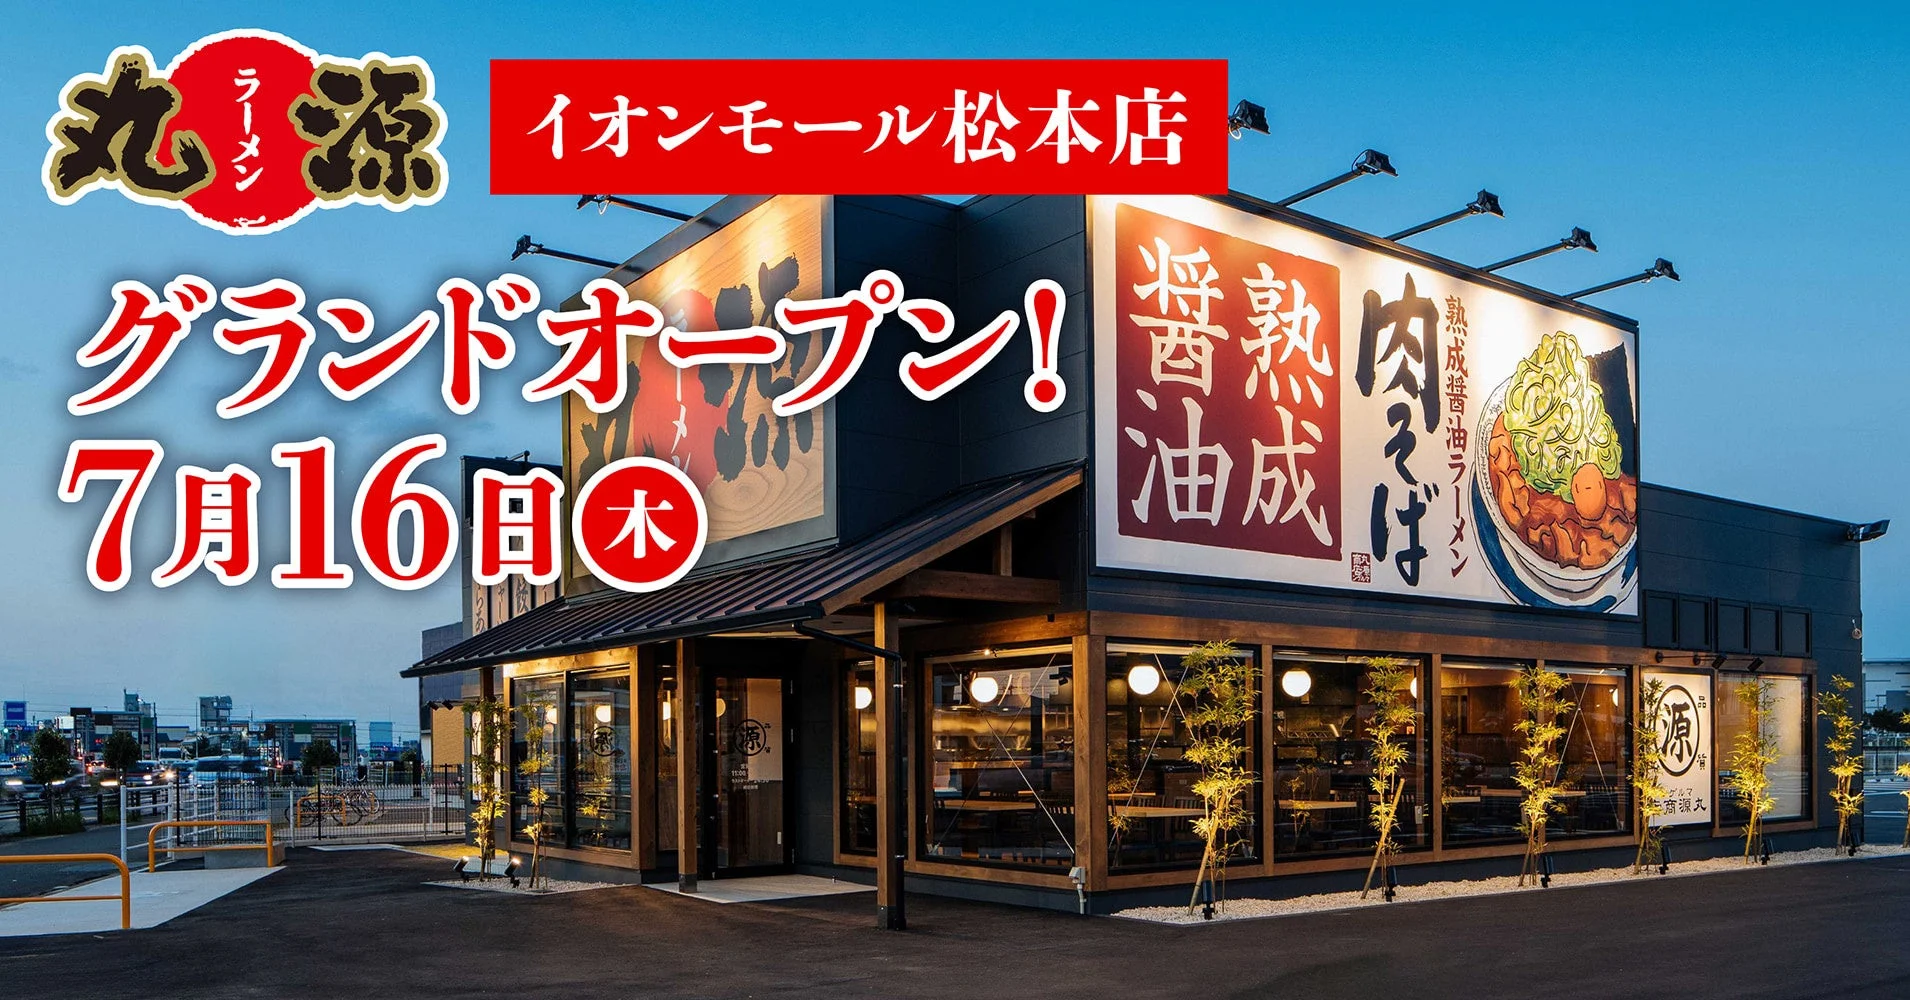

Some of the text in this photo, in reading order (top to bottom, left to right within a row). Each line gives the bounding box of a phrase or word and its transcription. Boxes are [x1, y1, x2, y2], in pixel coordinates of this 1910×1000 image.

[1123, 236, 1234, 529] 醤油
[1240, 261, 1335, 548] 熟成
[1354, 271, 1440, 588] 肉そば
[1443, 293, 1470, 579] 熟成醤油ラーメン
[1661, 701, 1693, 764] 源
